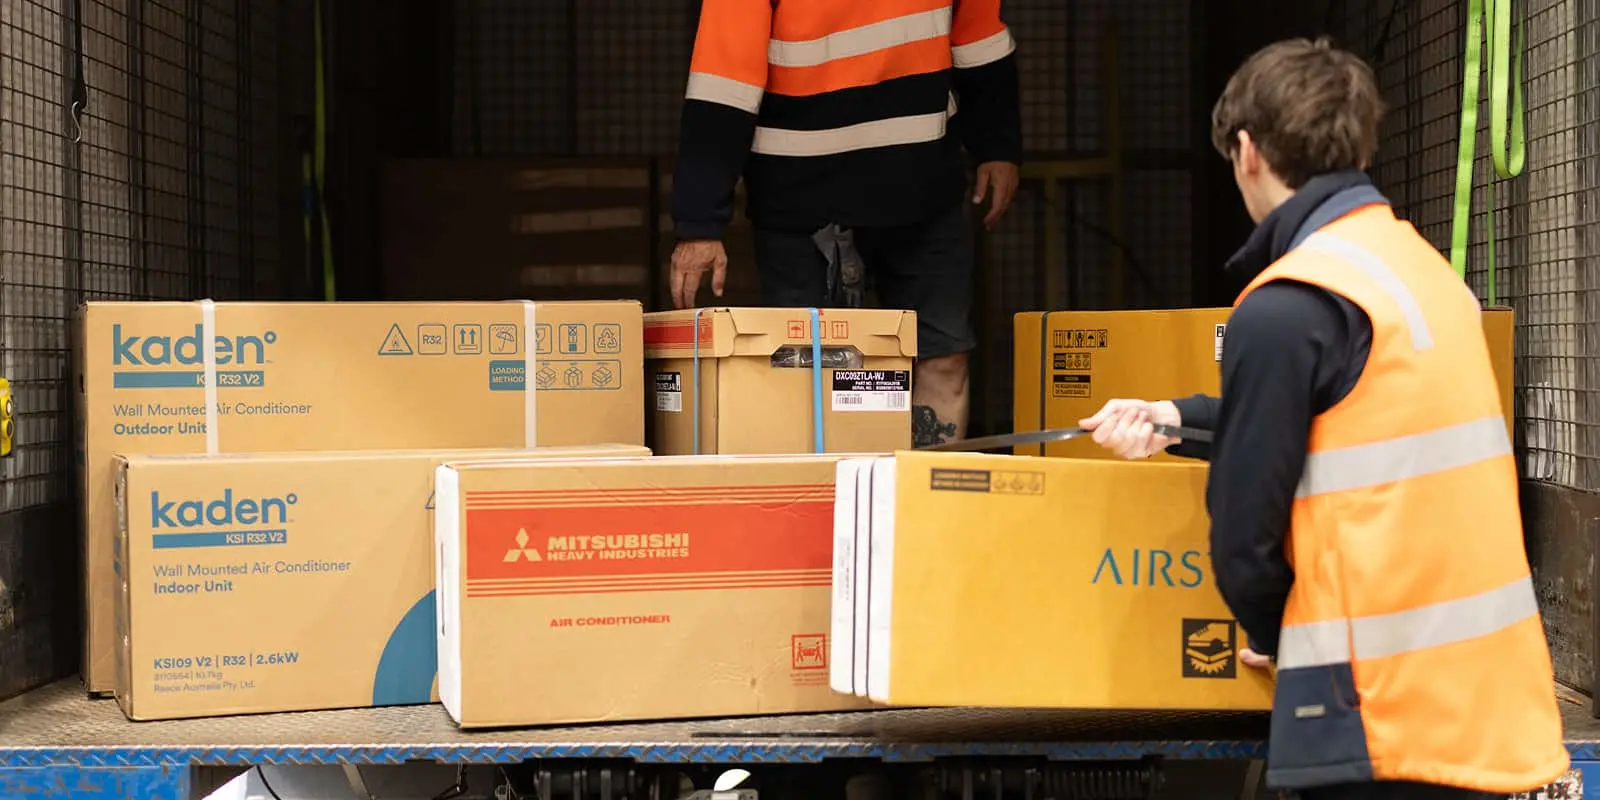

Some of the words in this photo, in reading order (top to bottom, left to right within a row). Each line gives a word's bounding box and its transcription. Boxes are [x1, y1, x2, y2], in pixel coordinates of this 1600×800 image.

[422, 335, 442, 345] R32
[219, 374, 241, 385] R32
[242, 373, 260, 384] V2
[113, 404, 142, 416] Wall
[235, 402, 312, 415] Conditioner
[113, 422, 174, 435] Outdoor
[178, 421, 207, 434] Unit
[225, 534, 244, 545] KSI
[246, 533, 266, 544] R32
[269, 532, 285, 543] V2
[547, 533, 689, 551] MITSUBISHI
[547, 551, 595, 561] HEAVY
[599, 548, 689, 560] INDUSTRIES
[153, 565, 183, 577] Wall
[187, 562, 248, 576] Mounted
[252, 561, 270, 574] Air
[275, 559, 352, 573] Conditioner
[1092, 548, 1212, 588] AIRS
[154, 581, 201, 594] Indoor
[204, 580, 233, 592] Unit
[550, 618, 573, 628] AIR
[576, 615, 671, 626] CONDITIONER
[153, 657, 193, 669] KSI09
[195, 655, 212, 667] V2
[223, 655, 246, 667] R32
[255, 651, 299, 665] 2.6kW
